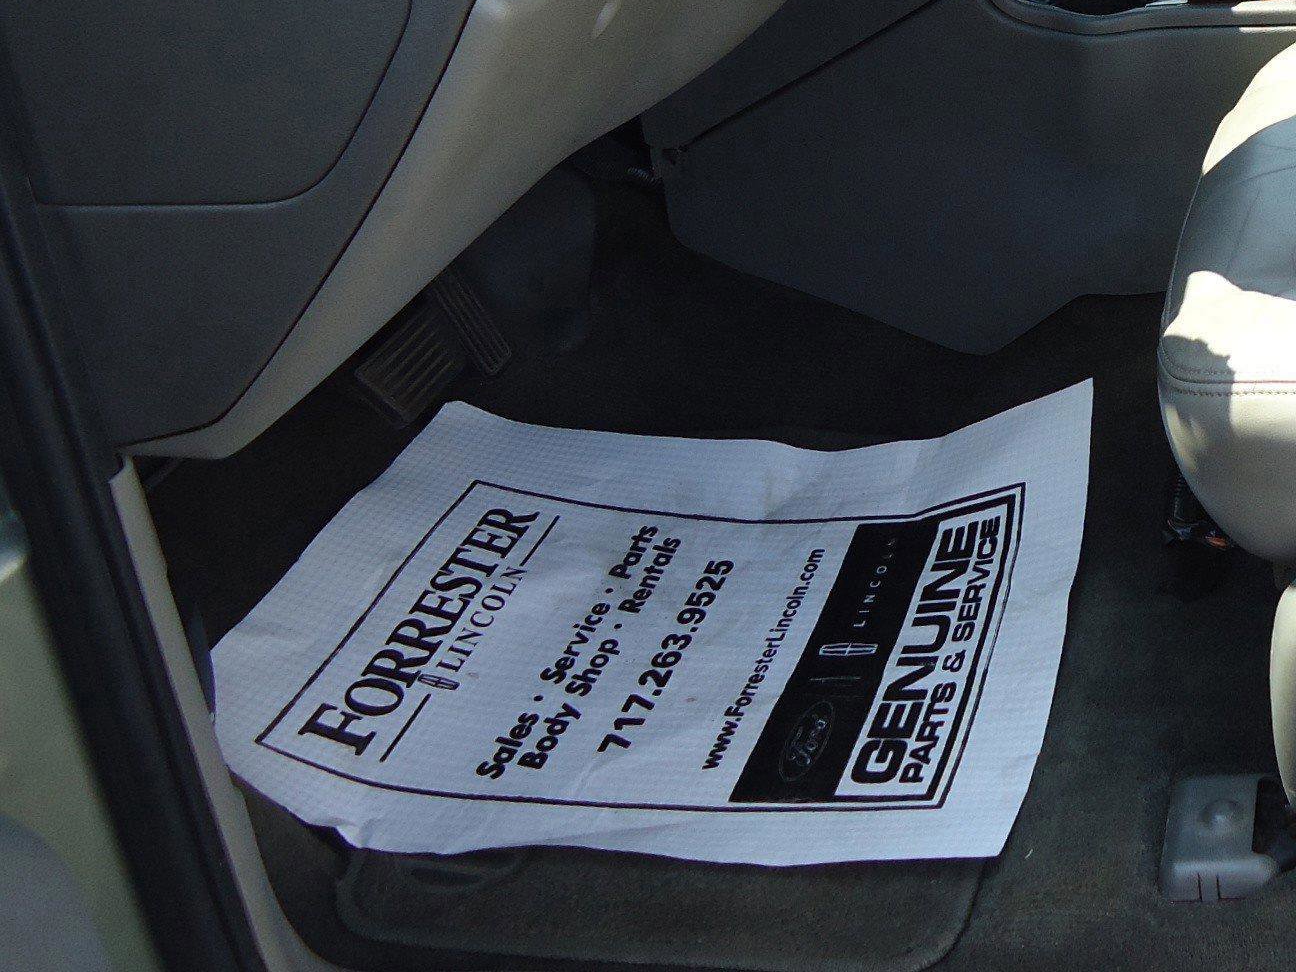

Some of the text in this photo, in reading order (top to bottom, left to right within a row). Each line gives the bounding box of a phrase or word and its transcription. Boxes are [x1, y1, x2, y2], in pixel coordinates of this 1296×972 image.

[298, 508, 540, 756] FORRESTER
[436, 567, 527, 673] LINCOLN
[476, 525, 658, 780] Sales Service Parts
[517, 537, 682, 769] Body Shop Rentals
[597, 560, 735, 753] 717.263.9525
[702, 548, 826, 770] www.ForresterLincoln.com
[851, 521, 980, 784] GENUINE
[898, 516, 1001, 784] PARTS & SERVICE
